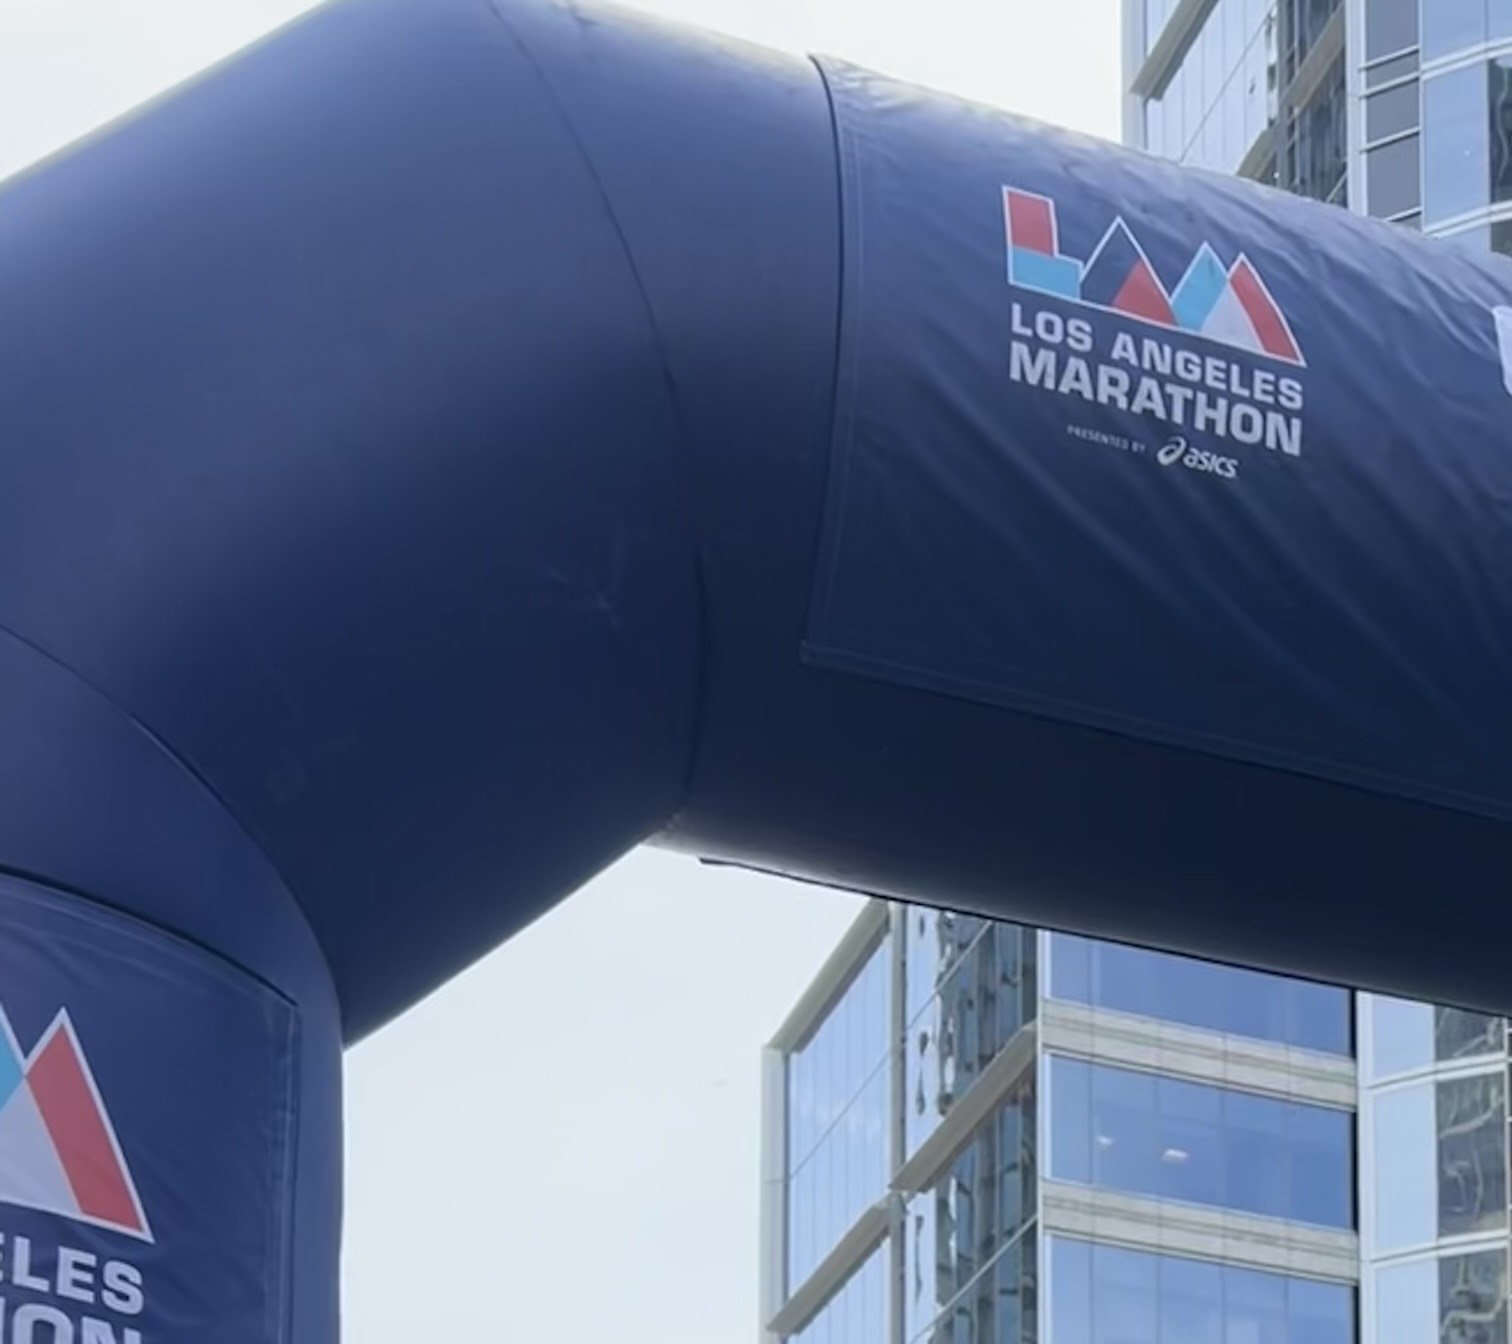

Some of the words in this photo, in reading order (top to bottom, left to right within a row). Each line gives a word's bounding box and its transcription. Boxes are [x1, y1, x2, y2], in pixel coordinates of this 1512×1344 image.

[1009, 341, 1302, 457] MARATHON
[1011, 302, 1093, 353] LOS
[1110, 332, 1303, 411] ANGELES
[0, 1232, 144, 1315] LES
